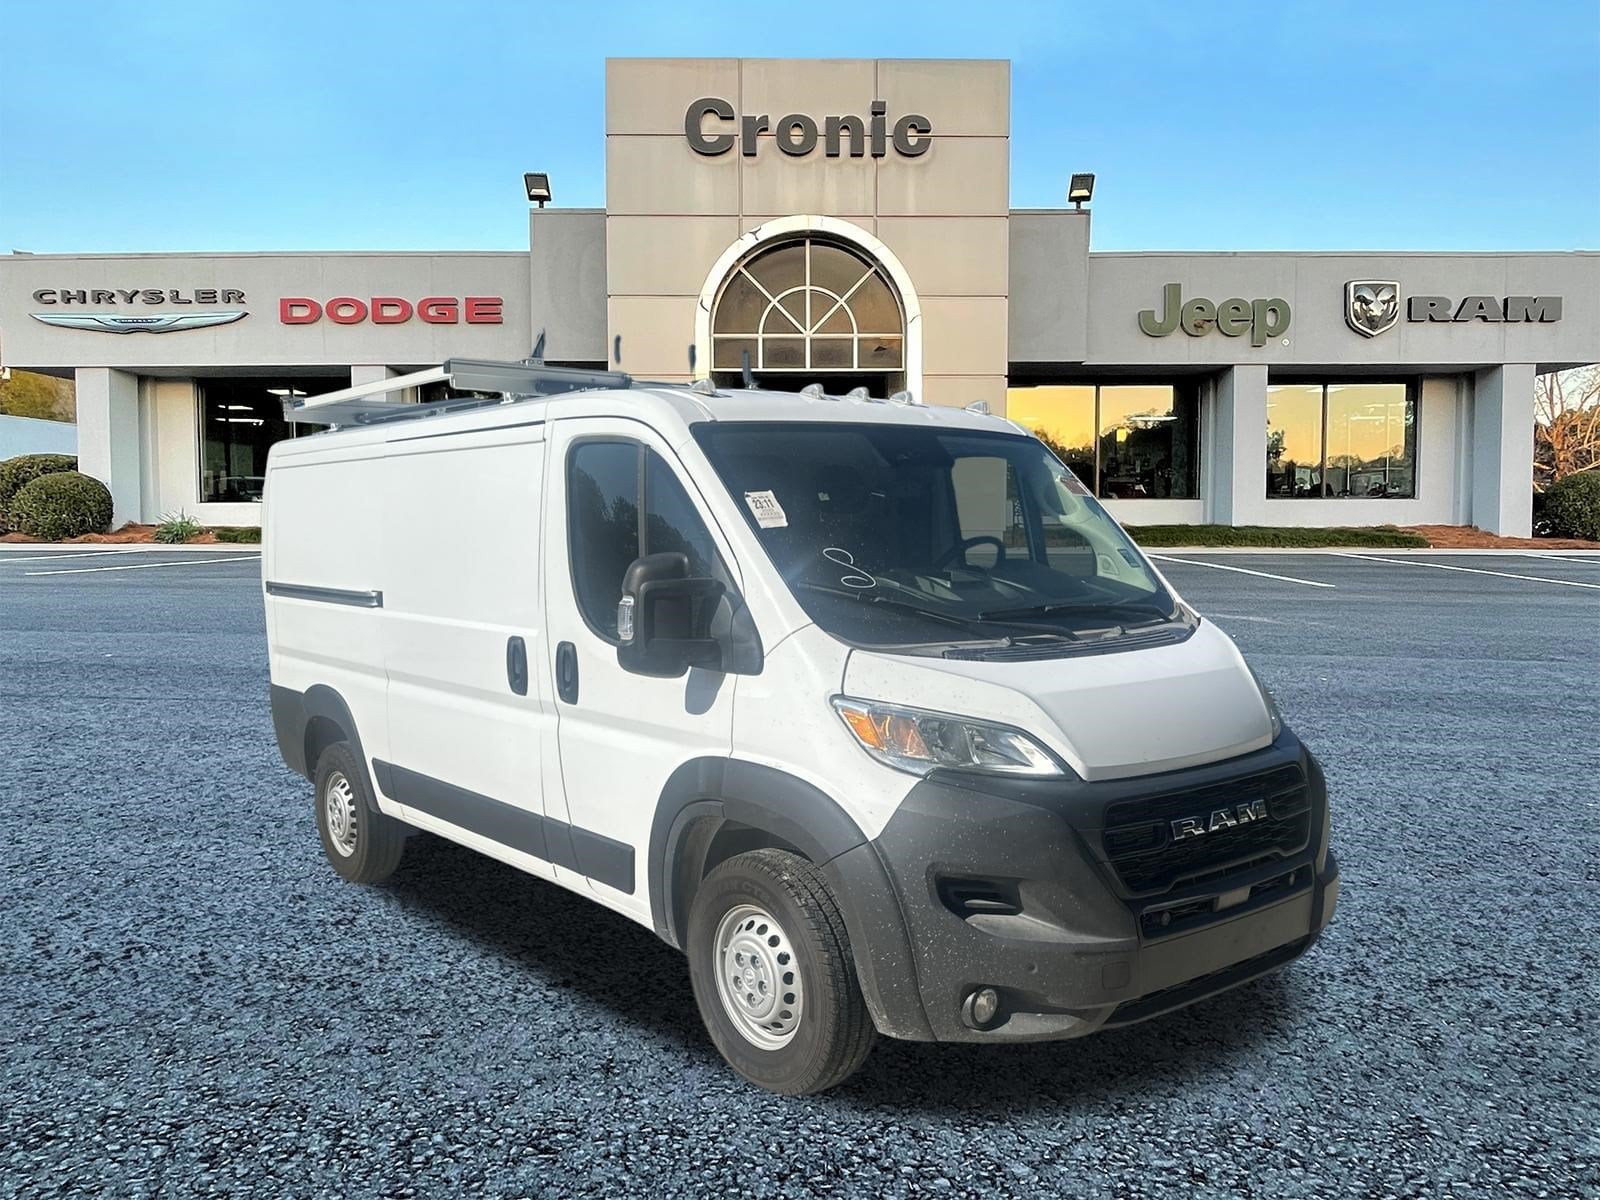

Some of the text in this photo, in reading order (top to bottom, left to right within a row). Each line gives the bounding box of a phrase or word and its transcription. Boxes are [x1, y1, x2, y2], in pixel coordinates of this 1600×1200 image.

[685, 98, 932, 157] Cronic
[32, 289, 246, 305] CHRYSLER
[280, 297, 504, 325] DODGE
[1407, 296, 1563, 322] RAM
[1138, 283, 1291, 347] Jeep
[1170, 799, 1268, 841] RAM
